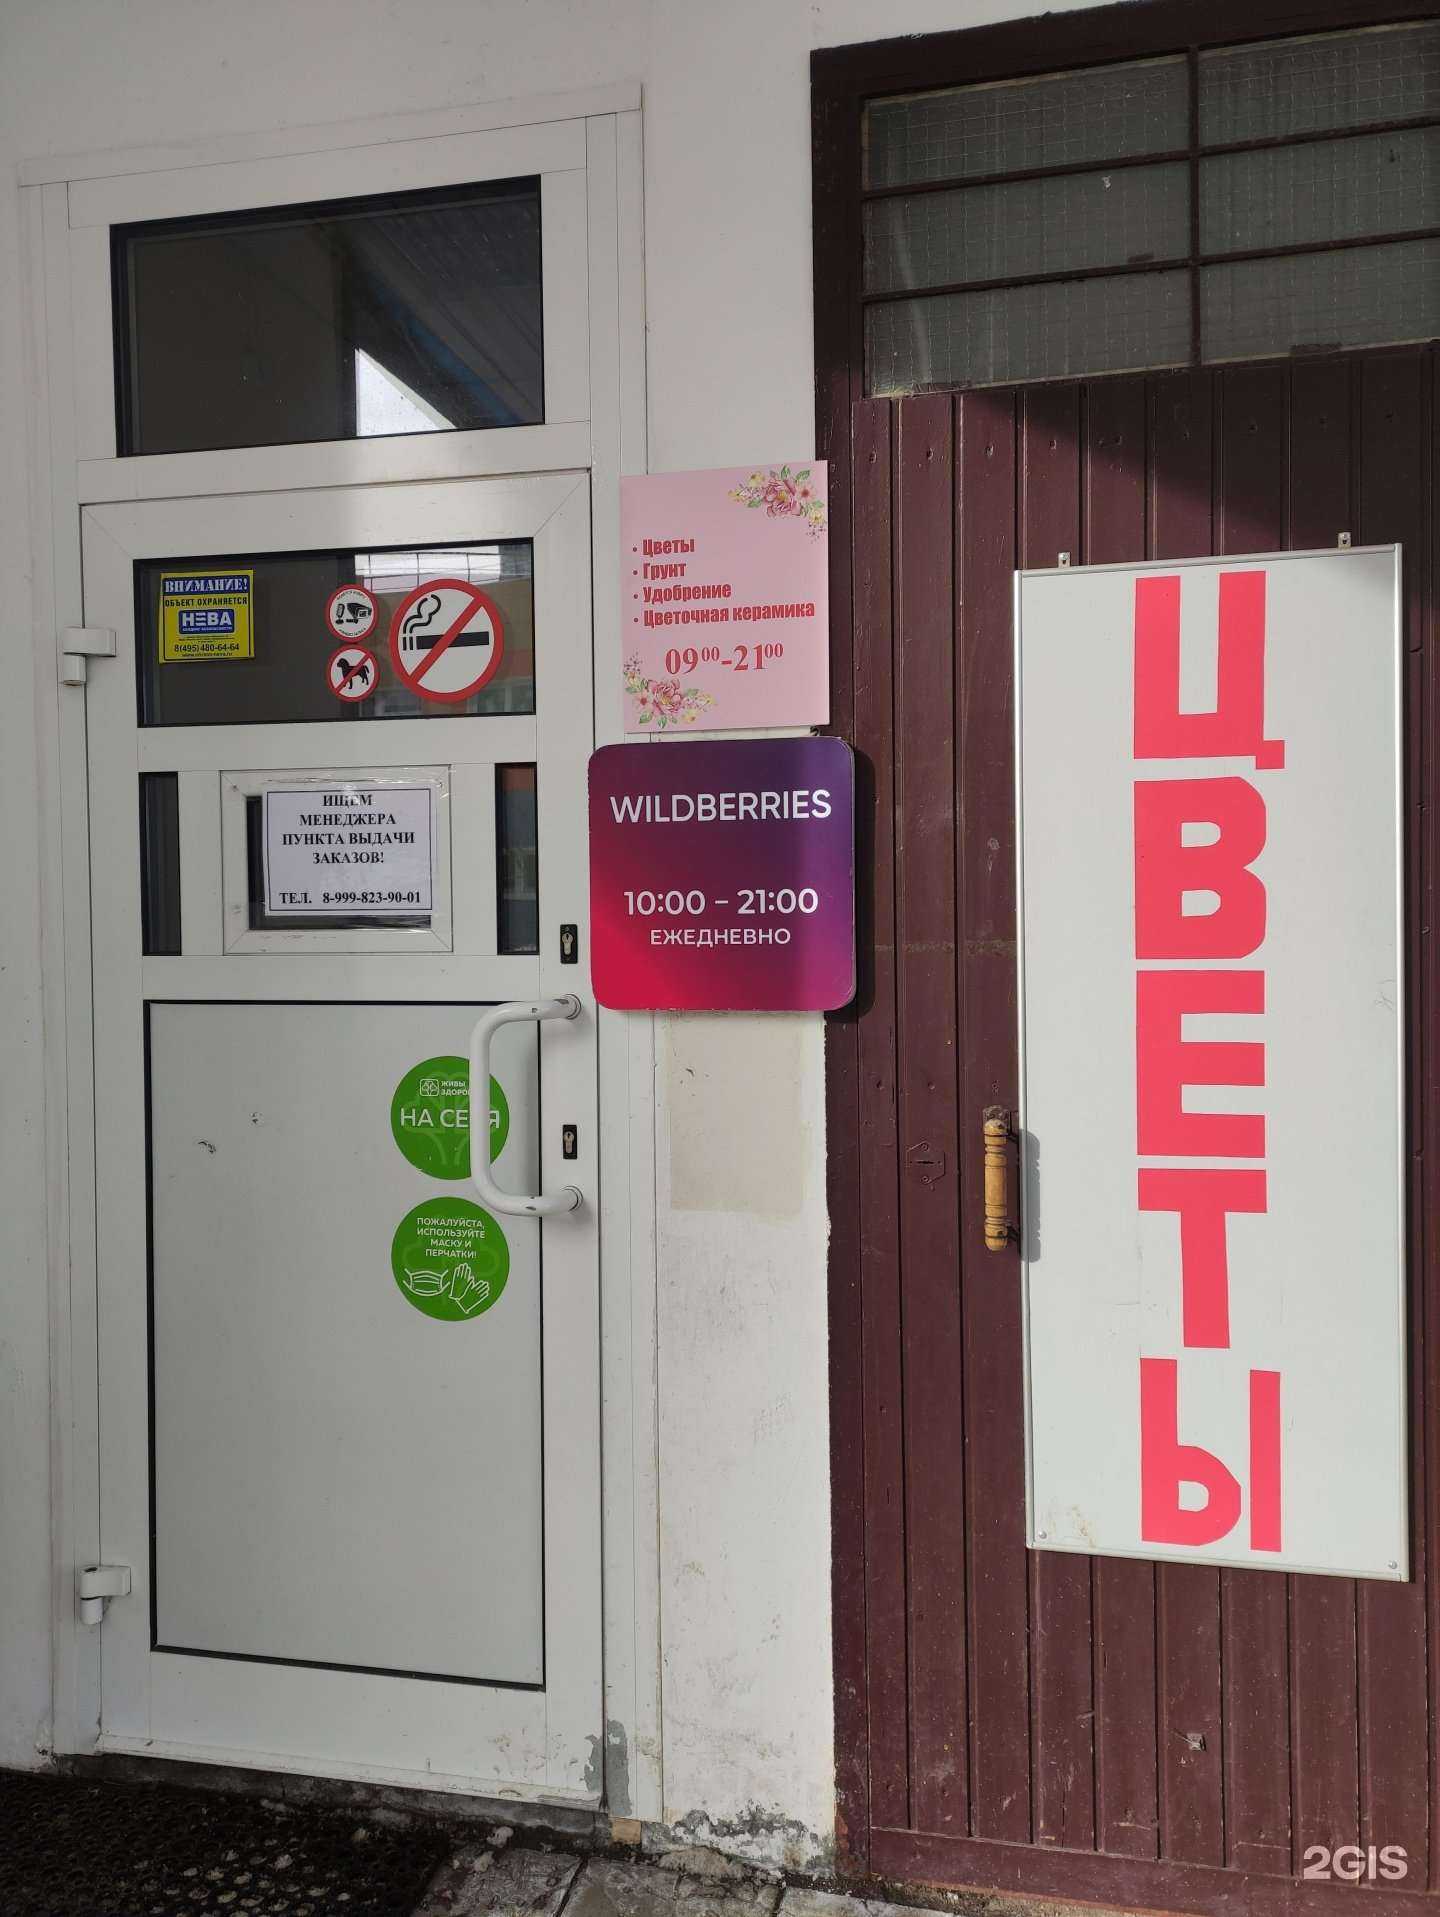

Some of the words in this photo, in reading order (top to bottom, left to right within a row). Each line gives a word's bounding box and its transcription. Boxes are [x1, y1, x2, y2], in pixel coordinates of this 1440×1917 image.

[642, 538, 695, 557] Цветы
[643, 563, 687, 580] Грунт
[165, 578, 248, 593] ВНИМАНИЕ!
[643, 583, 731, 604] Удобрение
[165, 599, 194, 607] ОБЪЕКТ
[197, 597, 247, 606] ОХРАНЯЕТСЯ
[182, 611, 232, 626] НЕВА
[644, 606, 729, 628] Цветочная
[732, 602, 815, 622] керамика
[323, 794, 372, 808] ИЩЕМ
[610, 789, 832, 823] WILDBERRIES
[299, 814, 396, 827] МЕНЕДЖЕРА
[282, 833, 345, 845] ПУНКТА
[349, 832, 415, 845] ВЫДАЧИ
[312, 852, 385, 864] ЗАКАЗОВ!
[279, 892, 312, 904] ТЕЛ.
[322, 891, 421, 904] 8-999-823-90-01
[623, 890, 706, 915] 10:00
[736, 888, 819, 914] 21:00
[650, 928, 791, 948] ЕЖЕДНЕВНО
[1134, 570, 1285, 1552] ЦВЕТЫ
[400, 1107, 434, 1127] НА
[439, 1109, 500, 1129] СЕЯ
[416, 1217, 485, 1229] ПОЖАЛУЙСТА,
[416, 1228, 485, 1238] ИСПОЛЬЗУЙТЕ
[430, 1239, 462, 1247] МАСКУ
[425, 1249, 477, 1259] ПЕРЧАТКИ!
